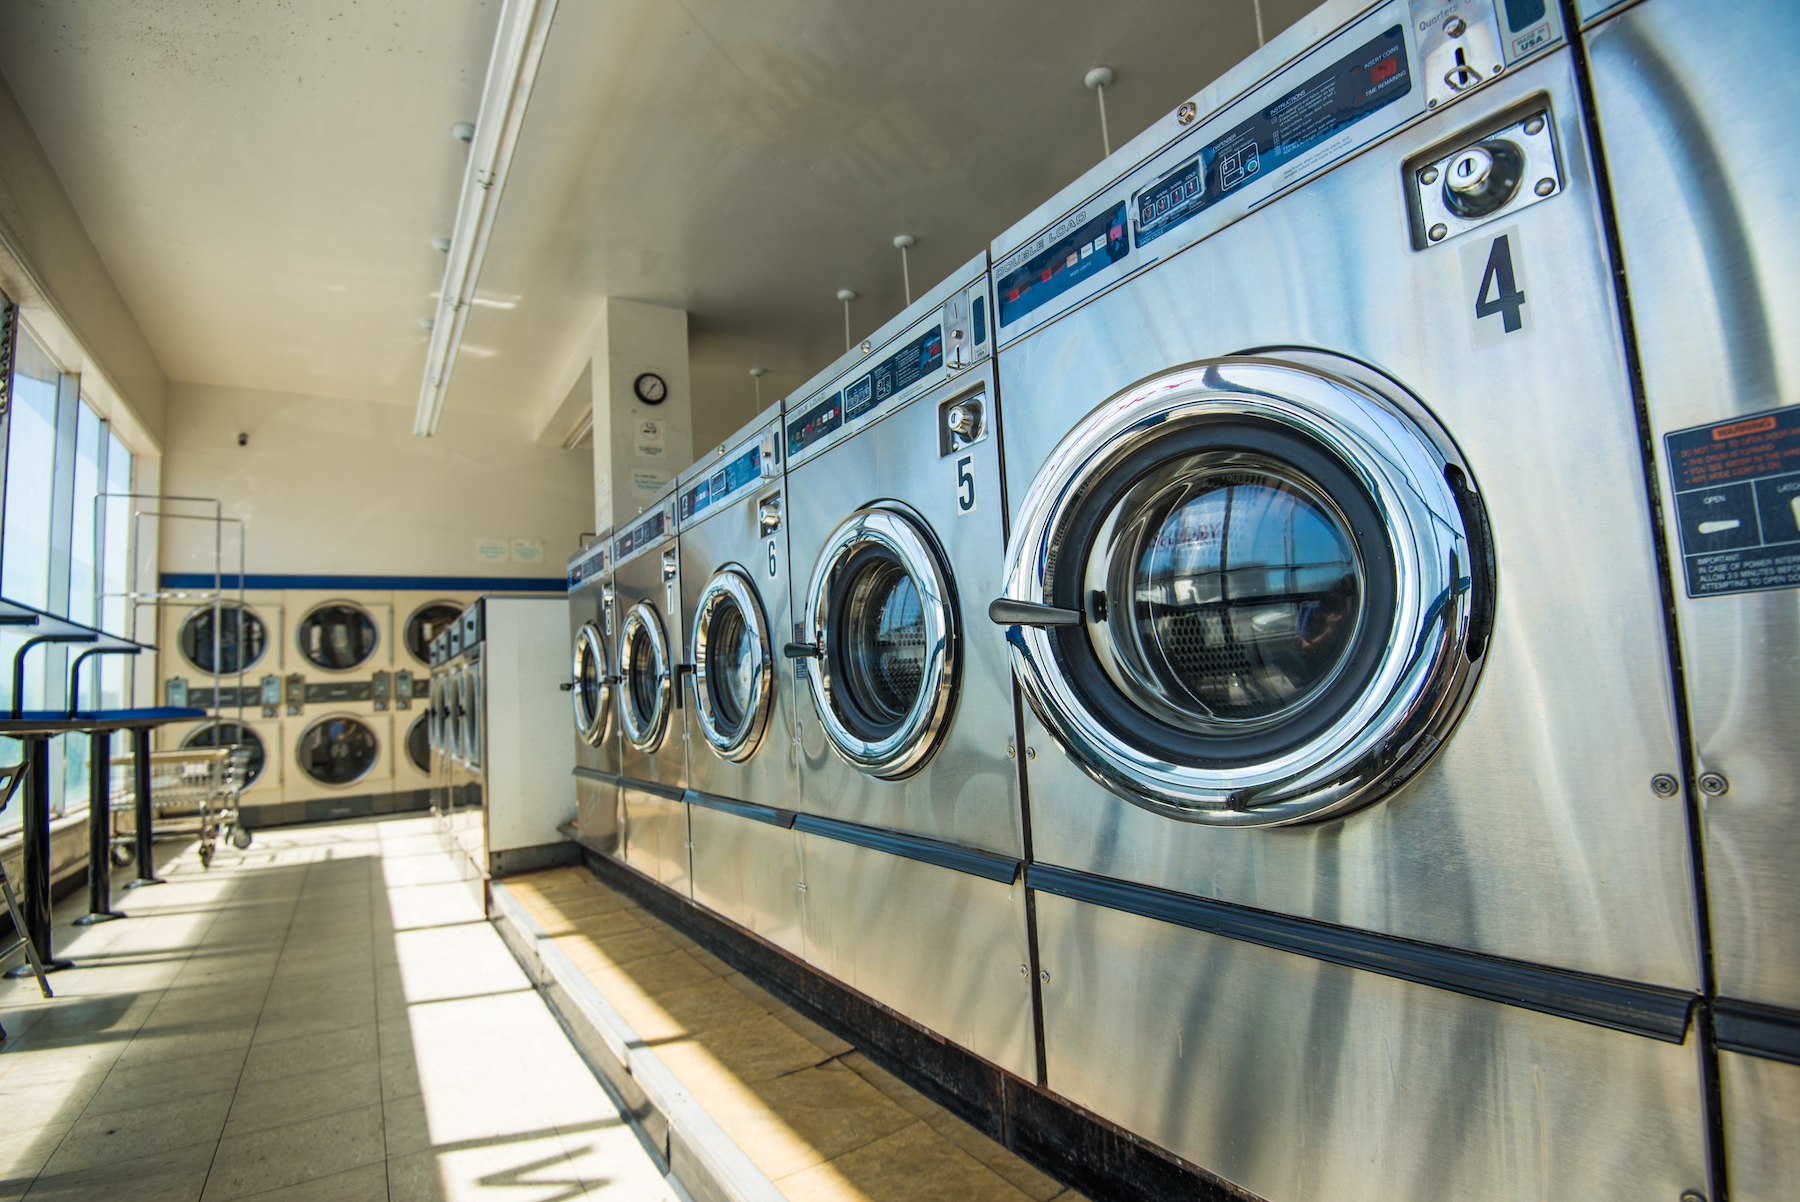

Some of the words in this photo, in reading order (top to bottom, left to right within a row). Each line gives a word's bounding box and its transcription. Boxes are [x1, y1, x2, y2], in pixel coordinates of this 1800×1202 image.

[1420, 4, 1459, 31] Quarters
[1517, 33, 1536, 46] MADE
[1521, 36, 1544, 50] USA
[1364, 56, 1382, 69] INSERT
[1382, 45, 1399, 58] COINS
[1365, 88, 1378, 97] TIME
[1378, 70, 1406, 90] REMAINING
[1270, 90, 1306, 115] INSTRUCTIONS
[996, 239, 1044, 278] DOUBLE
[1049, 211, 1086, 243] LOAD
[1476, 234, 1525, 334] 4
[1716, 420, 1772, 437] WARNING
[1681, 450, 1692, 458] DO
[1693, 446, 1709, 455] NOT
[1711, 442, 1726, 451] TRY
[1728, 439, 1740, 448] TO
[1741, 436, 1763, 446] OPEN
[1764, 430, 1789, 441] DOOR
[1705, 452, 1728, 463] DRUM
[1730, 450, 1738, 458] IS
[1740, 443, 1775, 456] TURNING
[1691, 466, 1707, 474] YOU
[1708, 462, 1723, 471] SEE
[1725, 457, 1752, 468] WATER
[1764, 451, 1780, 460] THE
[1691, 475, 1707, 483] ANY
[1708, 470, 1731, 480] MODE
[1732, 465, 1755, 476] LIGHT
[1767, 461, 1780, 470] ON
[957, 456, 974, 510] 5
[1703, 494, 1726, 505] OPEN
[768, 540, 776, 577] 6
[1708, 564, 1728, 573] CASE
[1730, 562, 1741, 570] OF
[1742, 558, 1773, 569] POWER
[1700, 580, 1748, 591] ATTEMPTING
[1750, 578, 1760, 586] TO
[1762, 575, 1786, 584] OPEN
[1740, 567, 1775, 578] MINUTES
[667, 584, 672, 613] 7
